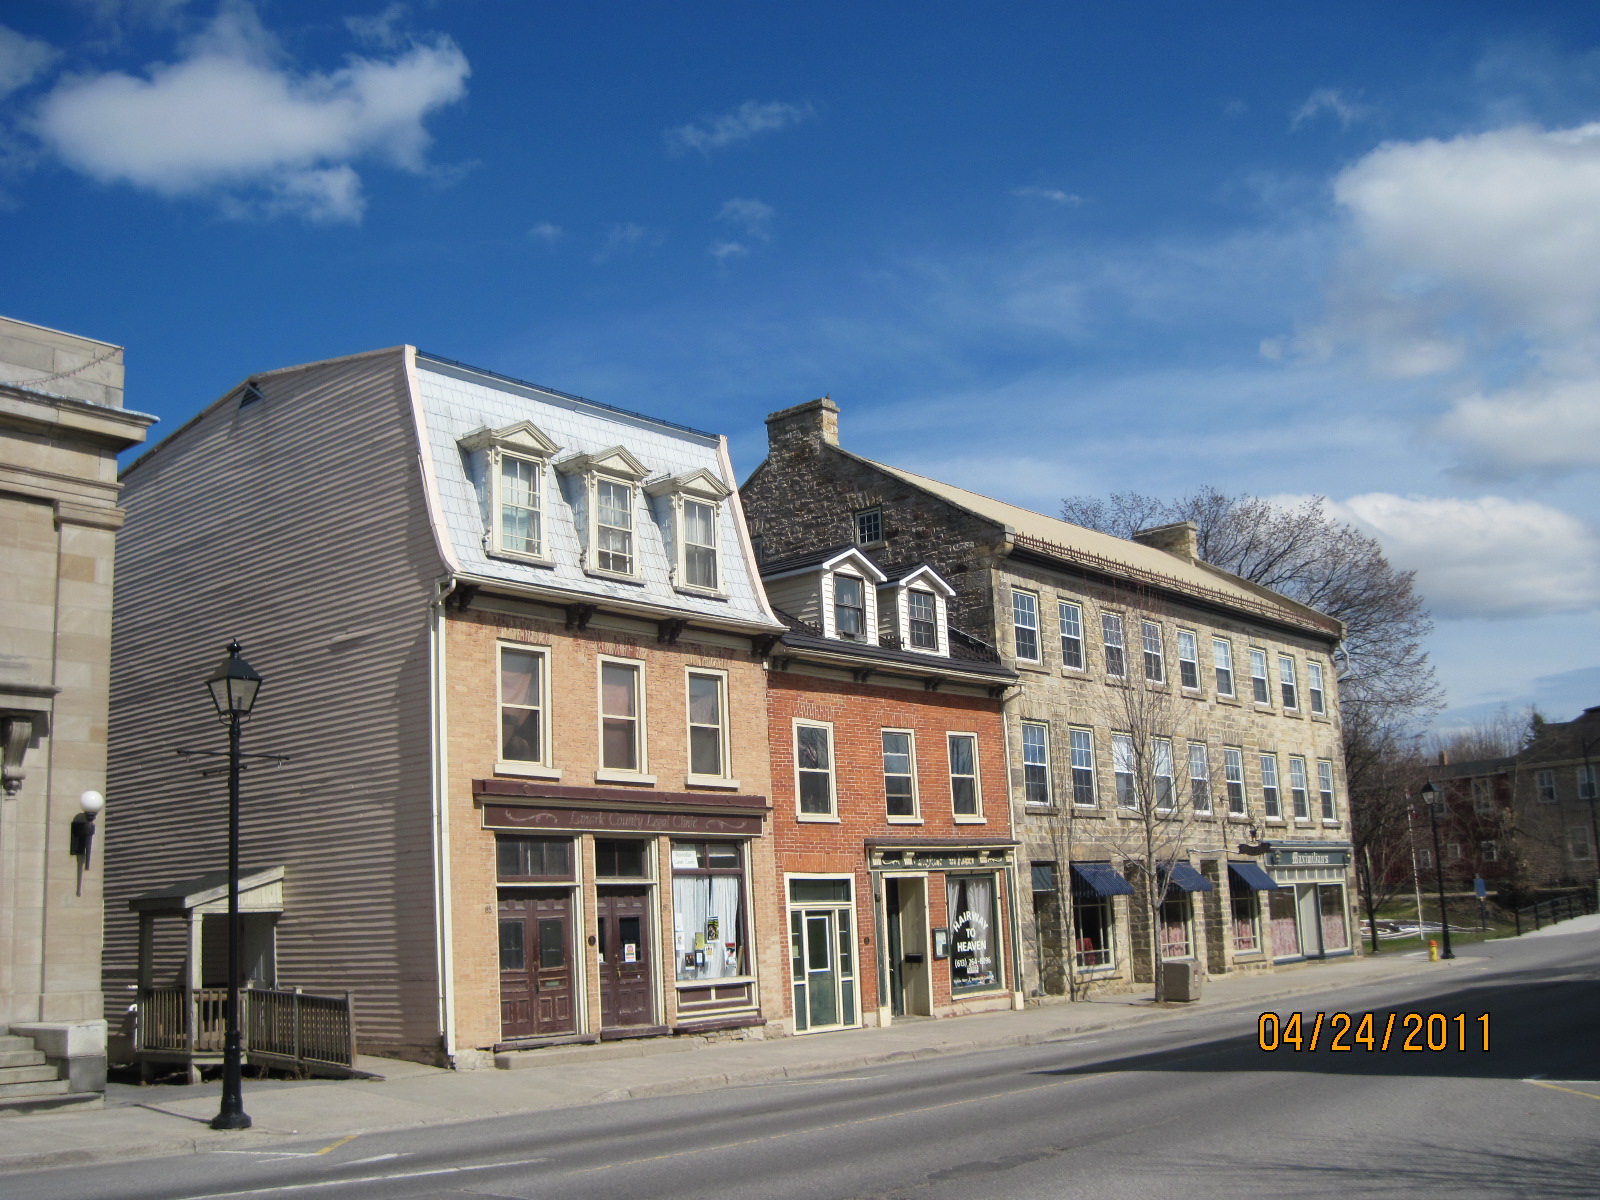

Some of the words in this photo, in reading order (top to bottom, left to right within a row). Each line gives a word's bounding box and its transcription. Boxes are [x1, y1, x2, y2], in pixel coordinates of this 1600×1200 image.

[570, 811, 604, 826] Lanark
[608, 812, 643, 831] County
[646, 814, 670, 830] Legal
[672, 815, 698, 829] Clinic
[952, 910, 989, 933] HAIRWAY
[965, 927, 976, 938] TO
[957, 940, 987, 952] HEAVEN
